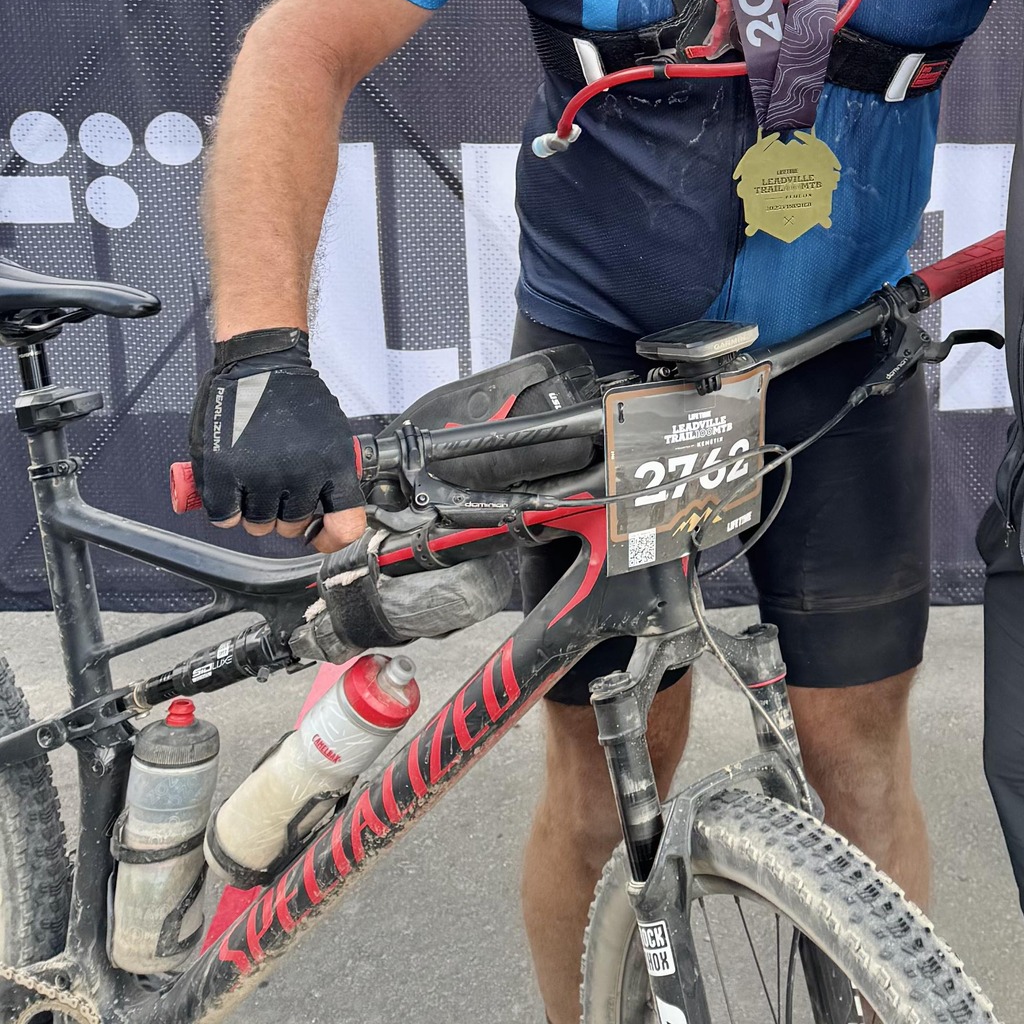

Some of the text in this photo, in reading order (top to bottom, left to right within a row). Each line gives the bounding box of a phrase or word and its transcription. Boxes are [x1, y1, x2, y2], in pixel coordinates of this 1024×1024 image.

[761, 174, 815, 186] LEADVILLE
[713, 334, 748, 351] GARMIN
[213, 387, 225, 420] PEARL
[672, 415, 727, 434] LEADVILLE
[634, 438, 750, 507] 2762
[219, 637, 521, 974] SPECIALIZED
